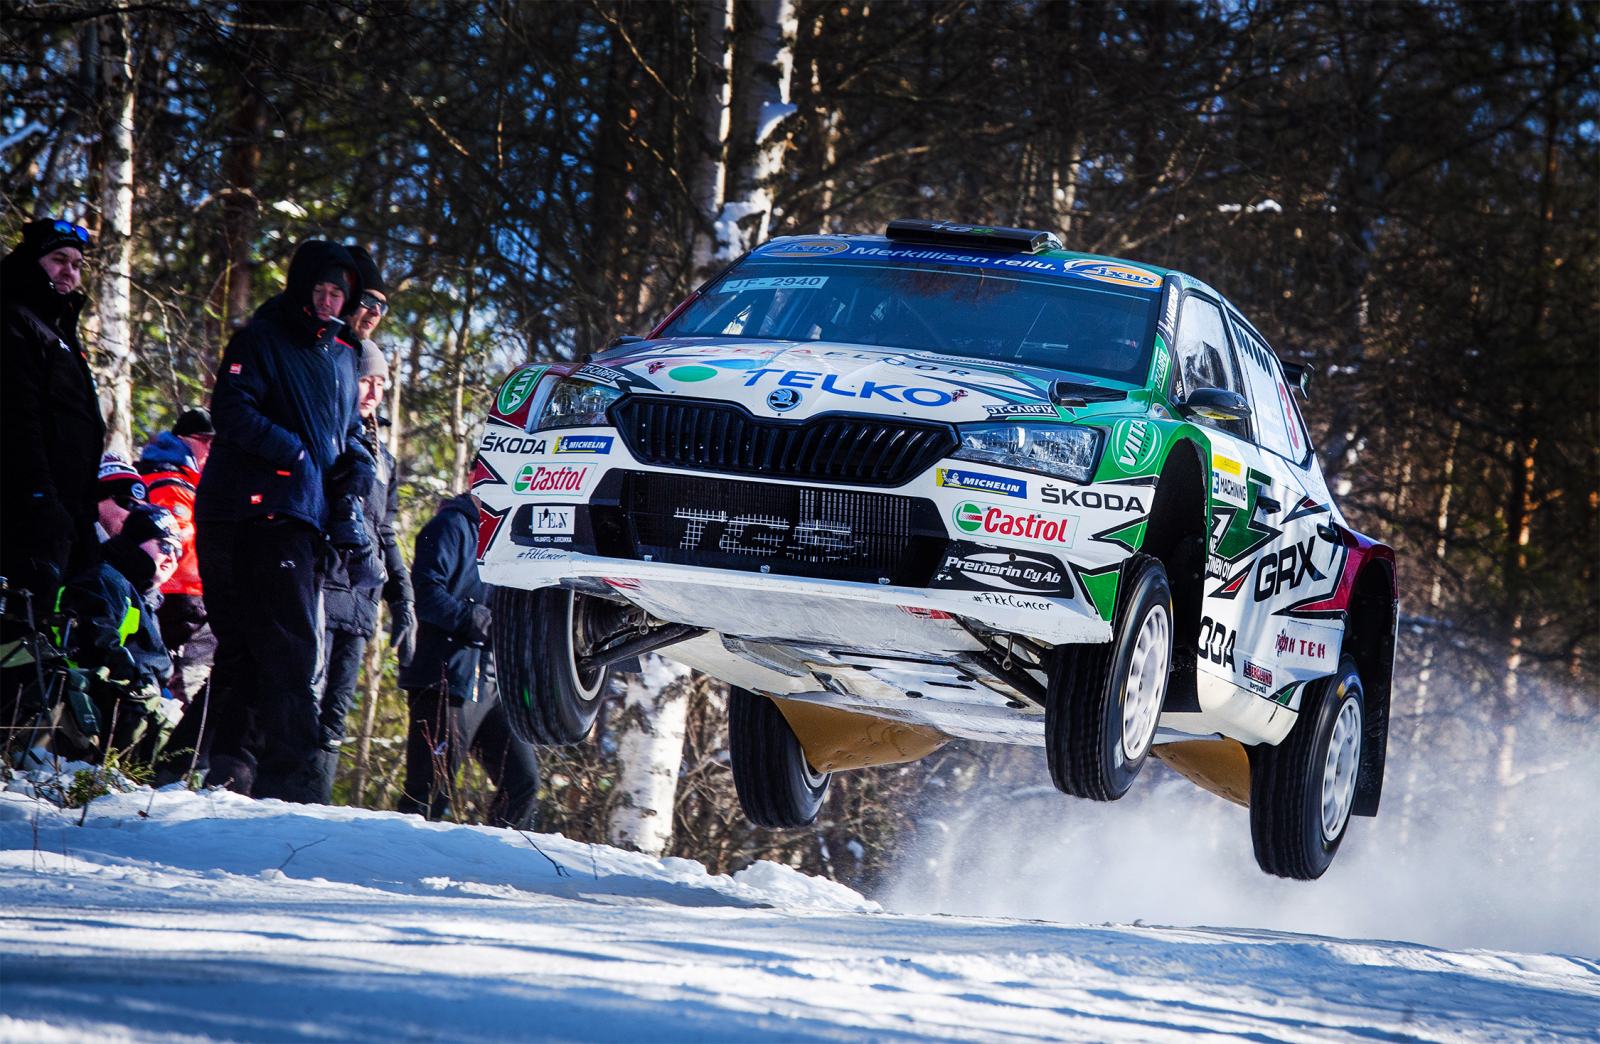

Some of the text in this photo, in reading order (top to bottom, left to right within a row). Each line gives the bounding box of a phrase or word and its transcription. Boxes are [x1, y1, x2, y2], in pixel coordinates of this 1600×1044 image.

[851, 246, 988, 264] Merkillisen
[744, 368, 953, 407] TELKO
[480, 432, 547, 455] ŠKODA
[568, 440, 607, 450] MICHELIN
[1118, 419, 1148, 467] VIITA
[530, 467, 588, 491] Castrol
[962, 477, 1020, 493] MICHELIN
[1040, 483, 1146, 514] ŠKODA
[984, 508, 1068, 543] Castrol
[944, 556, 1062, 584] Premarin Oy Ab
[1254, 535, 1328, 603] GRX
